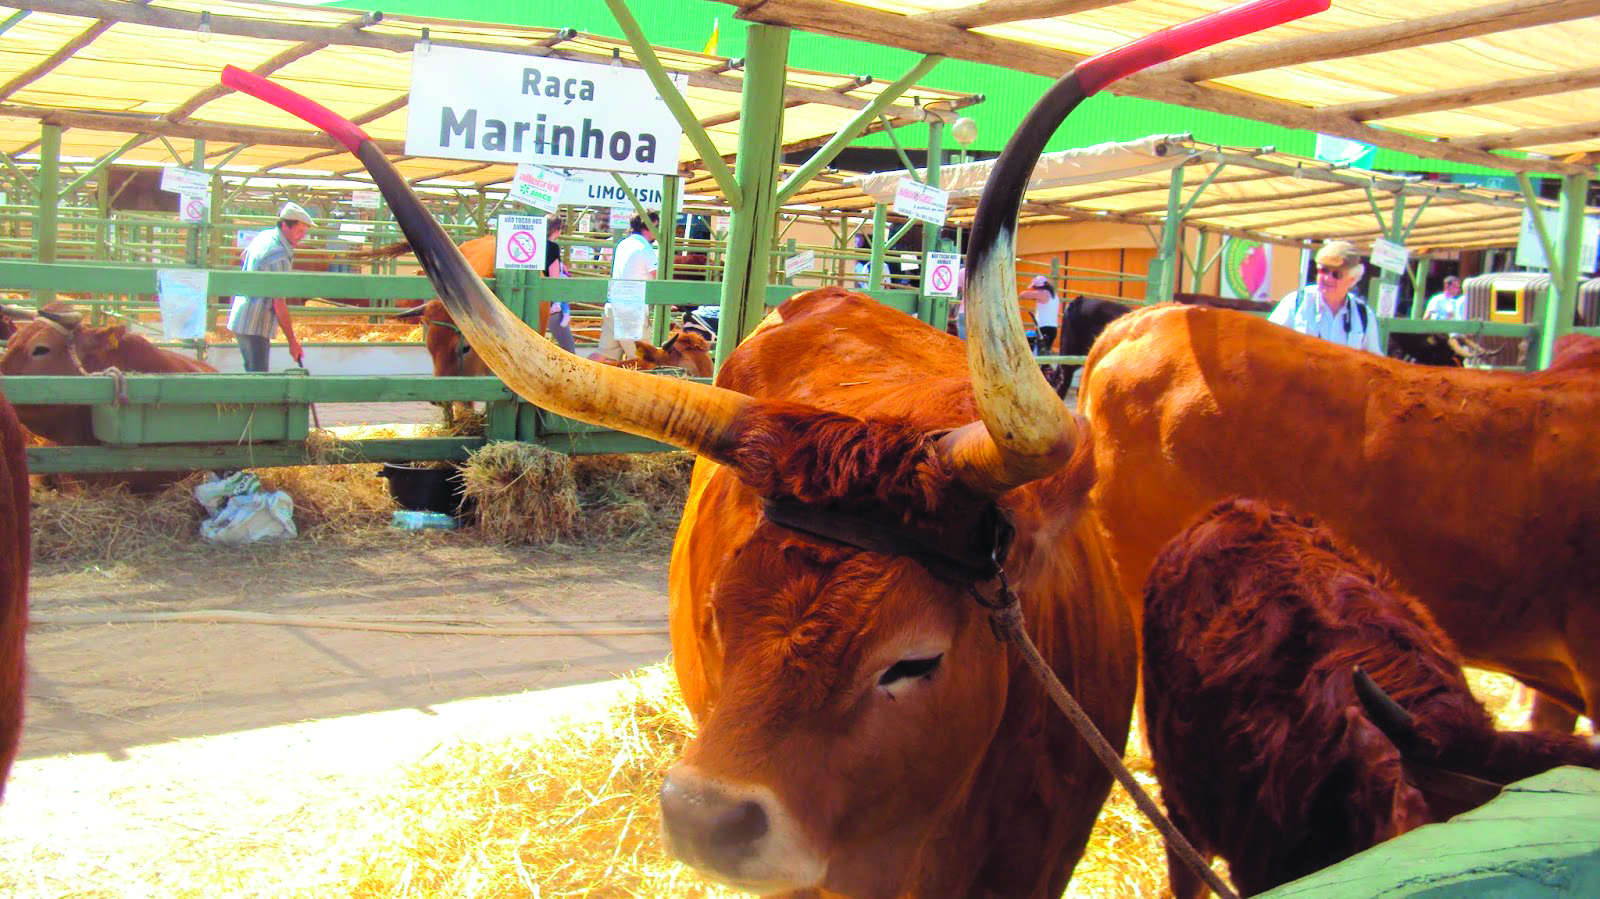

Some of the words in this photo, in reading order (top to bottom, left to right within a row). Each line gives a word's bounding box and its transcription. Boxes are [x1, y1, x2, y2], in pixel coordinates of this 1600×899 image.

[521, 67, 595, 106] Raça
[440, 106, 657, 164] Marinhoa
[530, 190, 552, 202] JMCS
